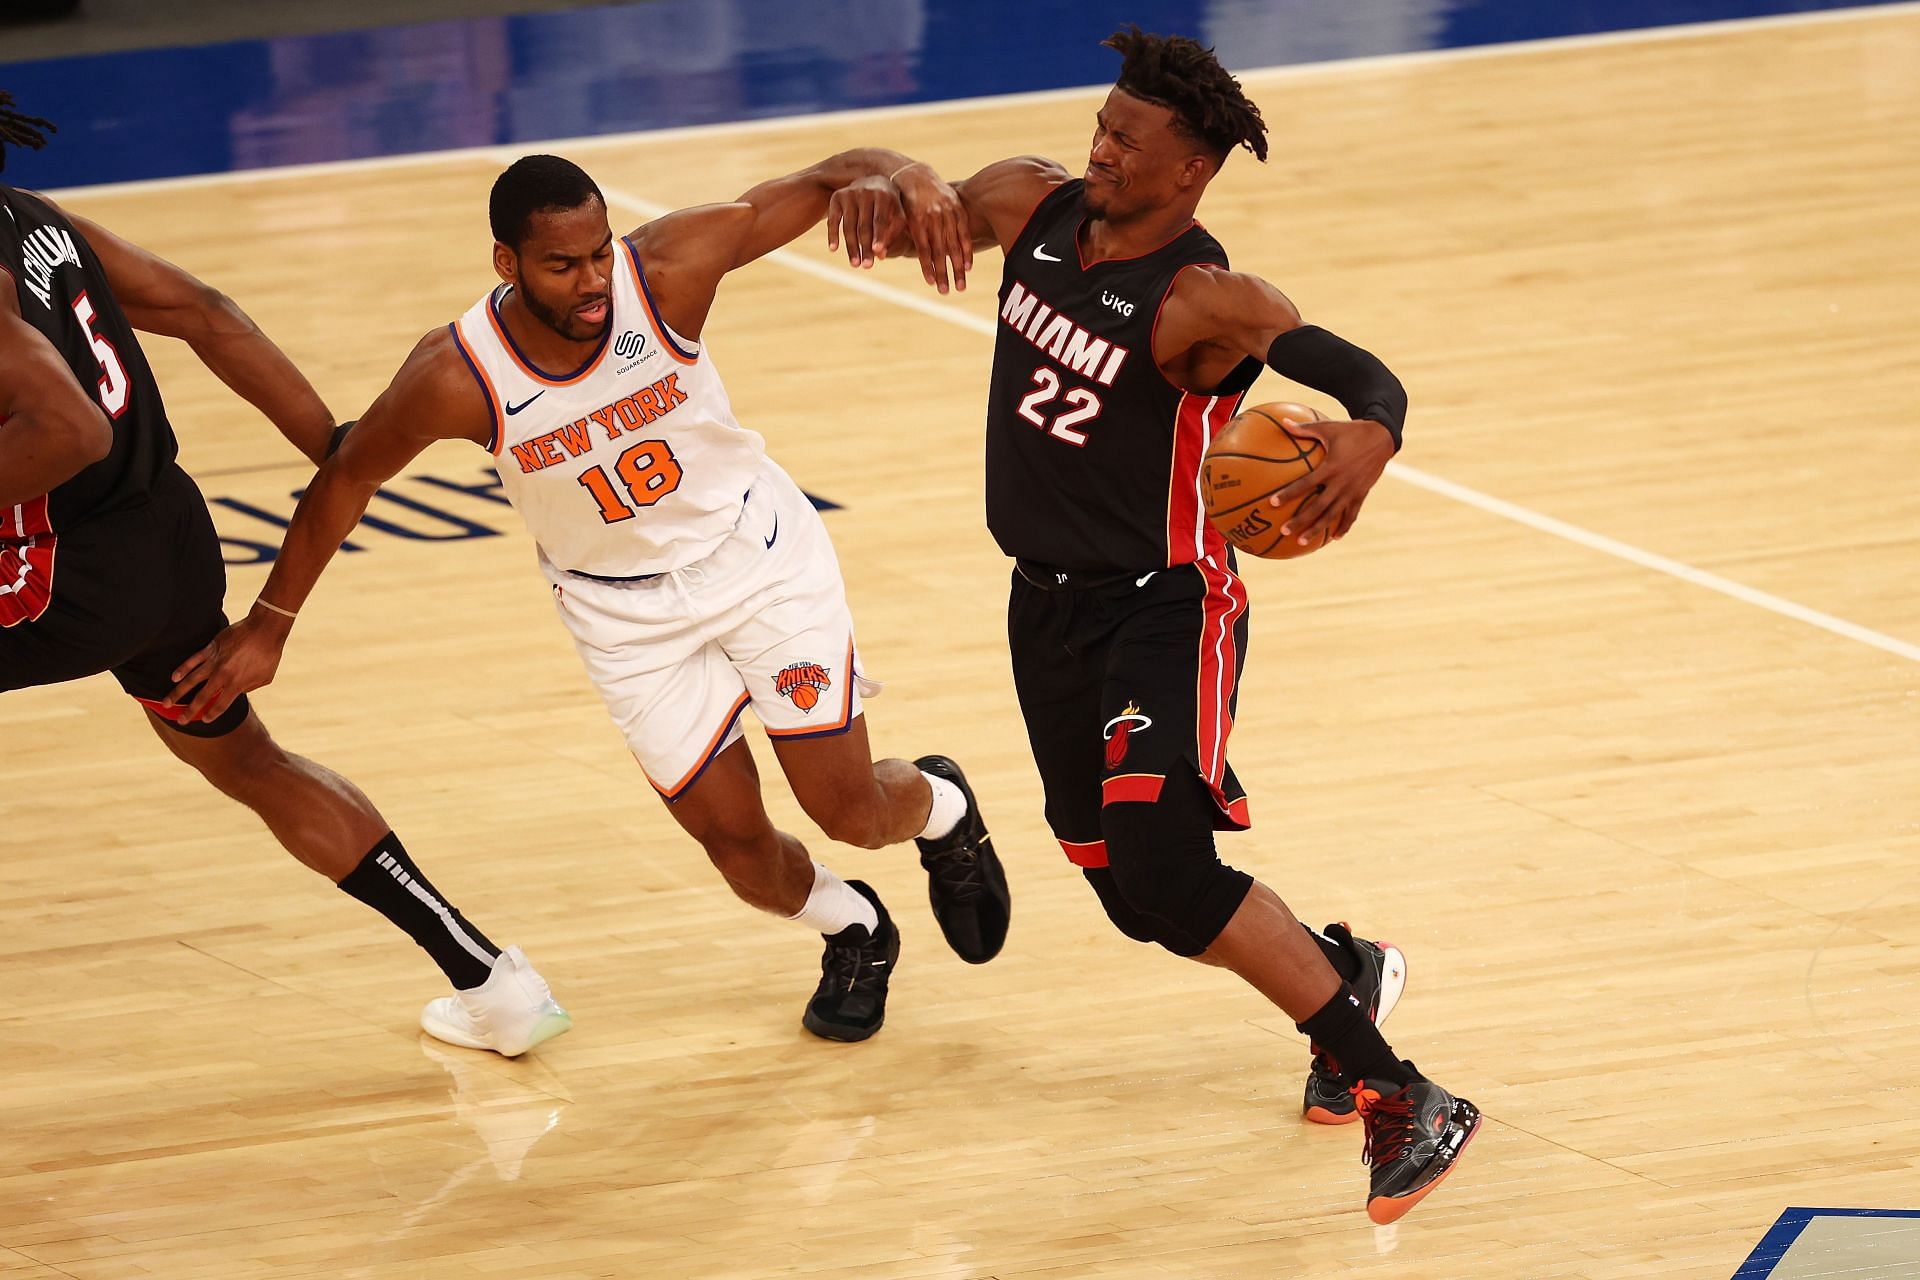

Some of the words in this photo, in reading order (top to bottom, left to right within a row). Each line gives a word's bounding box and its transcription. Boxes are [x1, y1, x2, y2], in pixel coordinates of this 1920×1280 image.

[71, 288, 132, 420] 5
[616, 349, 658, 376] SQUARESPACE
[1001, 280, 1130, 388] MIAMI
[510, 414, 592, 474] NEW
[589, 373, 688, 440] YORK
[1016, 365, 1103, 448] 22
[577, 439, 683, 525] 18
[776, 664, 831, 694] KNICKS
